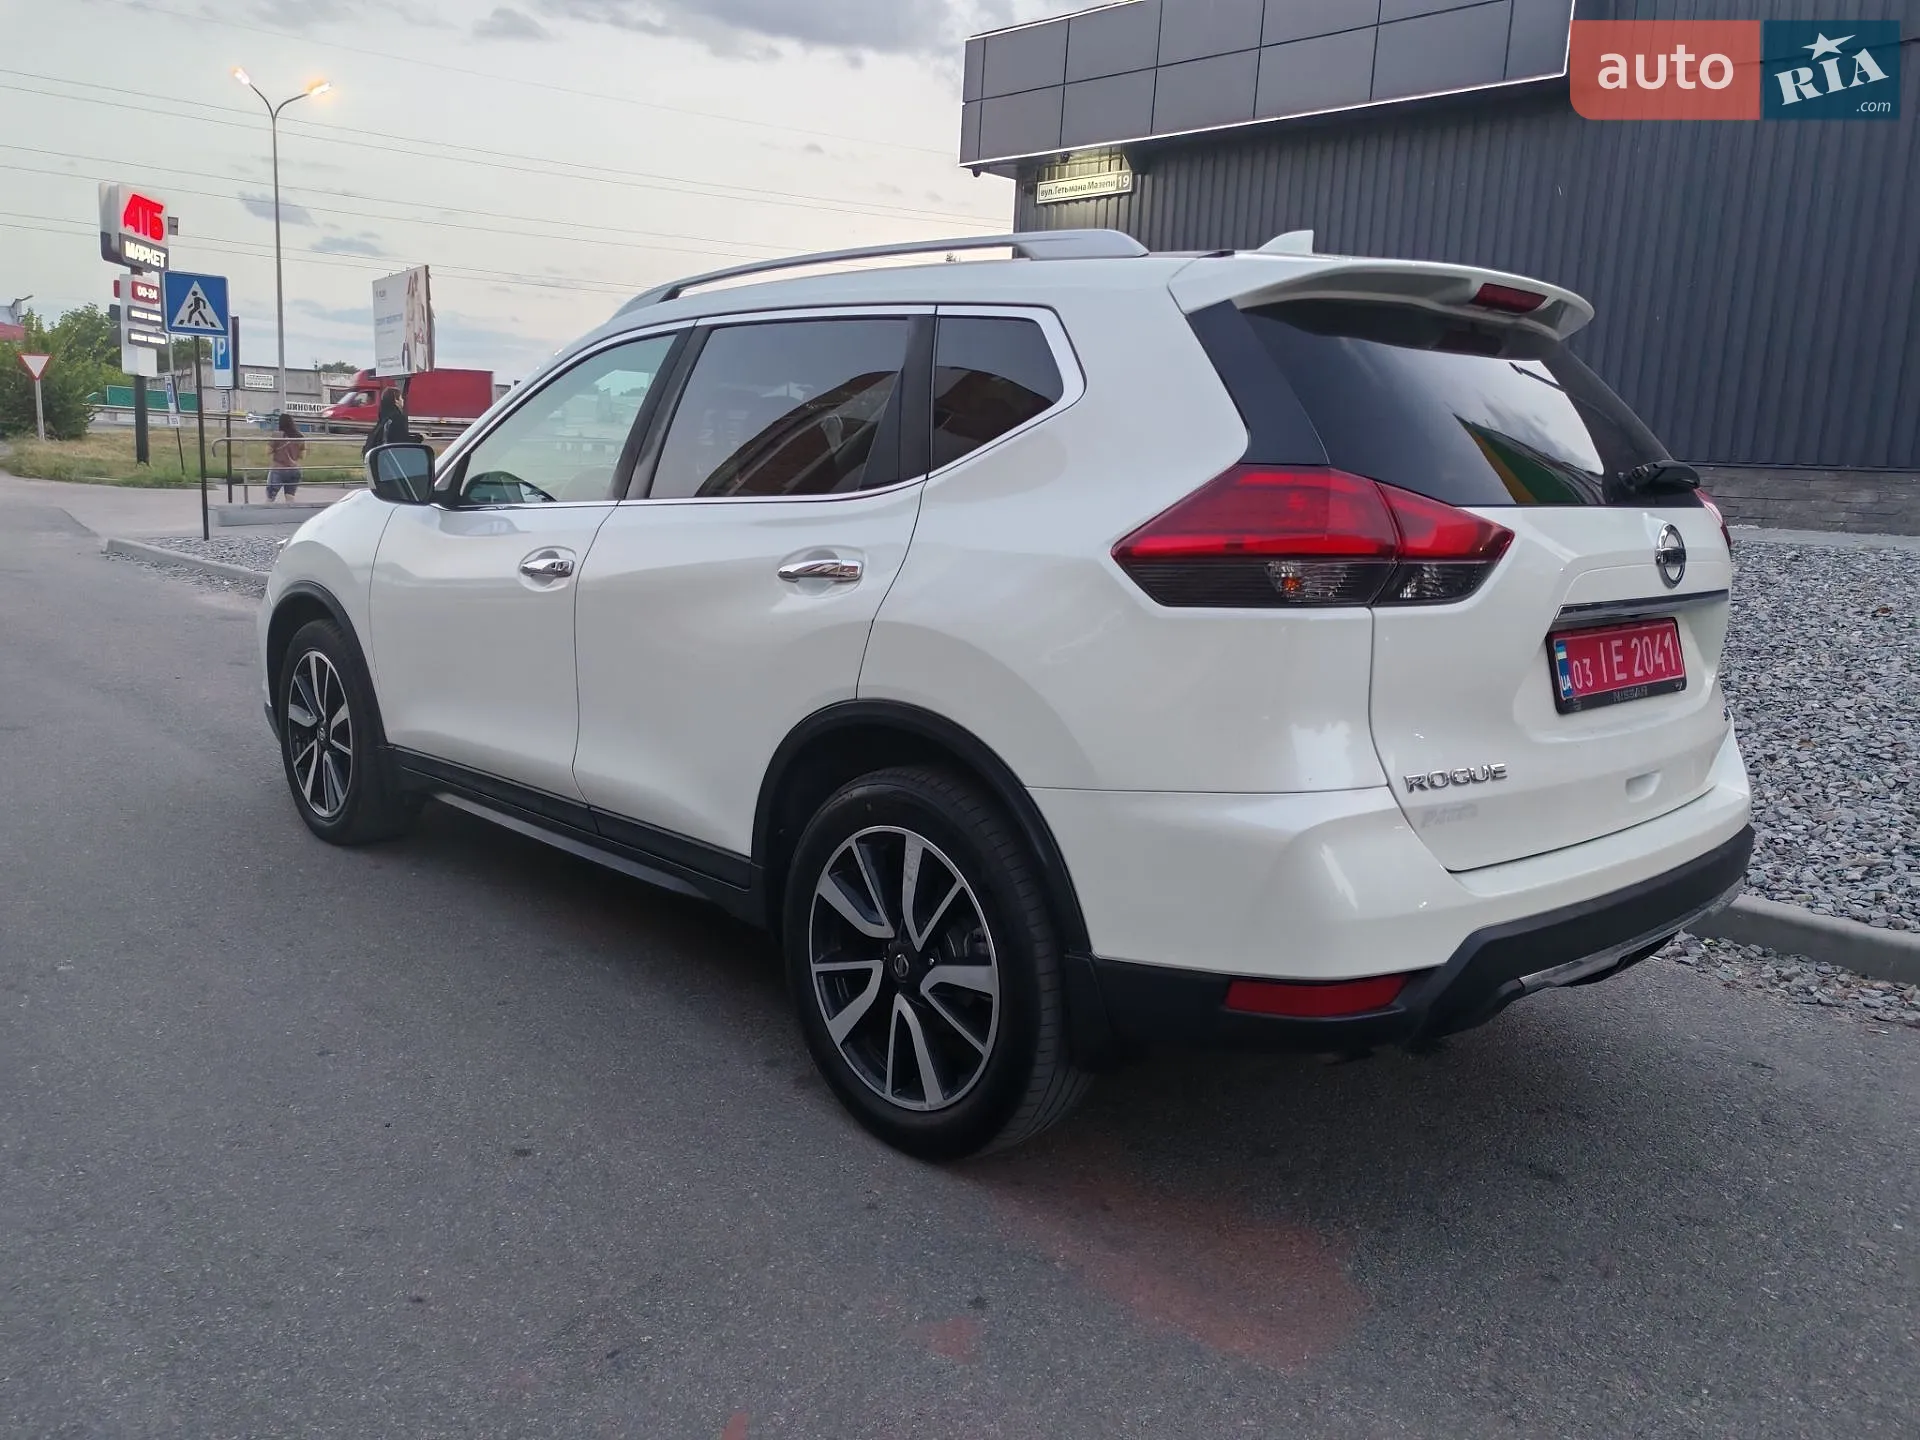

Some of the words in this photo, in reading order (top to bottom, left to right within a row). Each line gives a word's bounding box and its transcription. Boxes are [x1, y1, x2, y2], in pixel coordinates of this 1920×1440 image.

[1117, 174, 1130, 188] 19
[123, 193, 164, 241] АТБ
[125, 241, 167, 268] МАРКЕТ
[1572, 658, 1593, 689] 03
[1599, 639, 1628, 684] IE
[1630, 631, 1677, 678] 2041
[1560, 675, 1573, 691] UA
[1403, 762, 1508, 793] ROGUE
